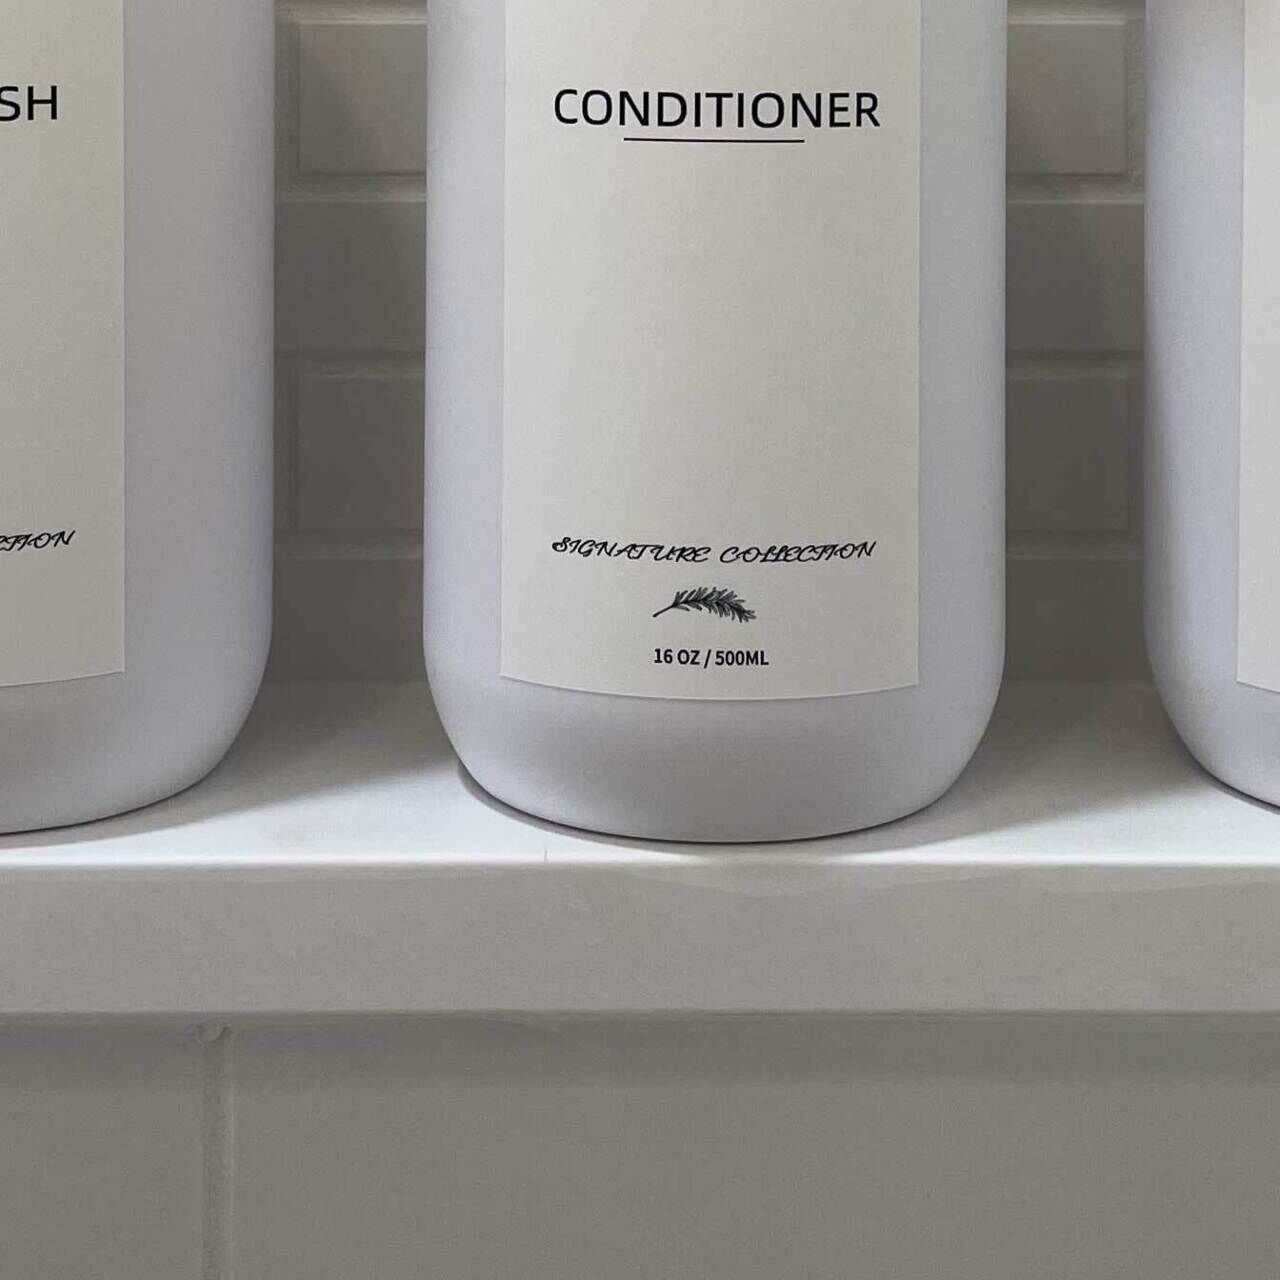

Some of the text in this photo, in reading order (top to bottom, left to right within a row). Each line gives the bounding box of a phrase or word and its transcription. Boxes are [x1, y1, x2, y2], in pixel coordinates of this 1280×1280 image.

[554, 88, 881, 129] CONDITIONER
[551, 536, 877, 564] SIGNATURE COLLECTION
[653, 647, 674, 665] 16
[676, 648, 701, 666] OZ
[714, 649, 770, 667] 500ML
